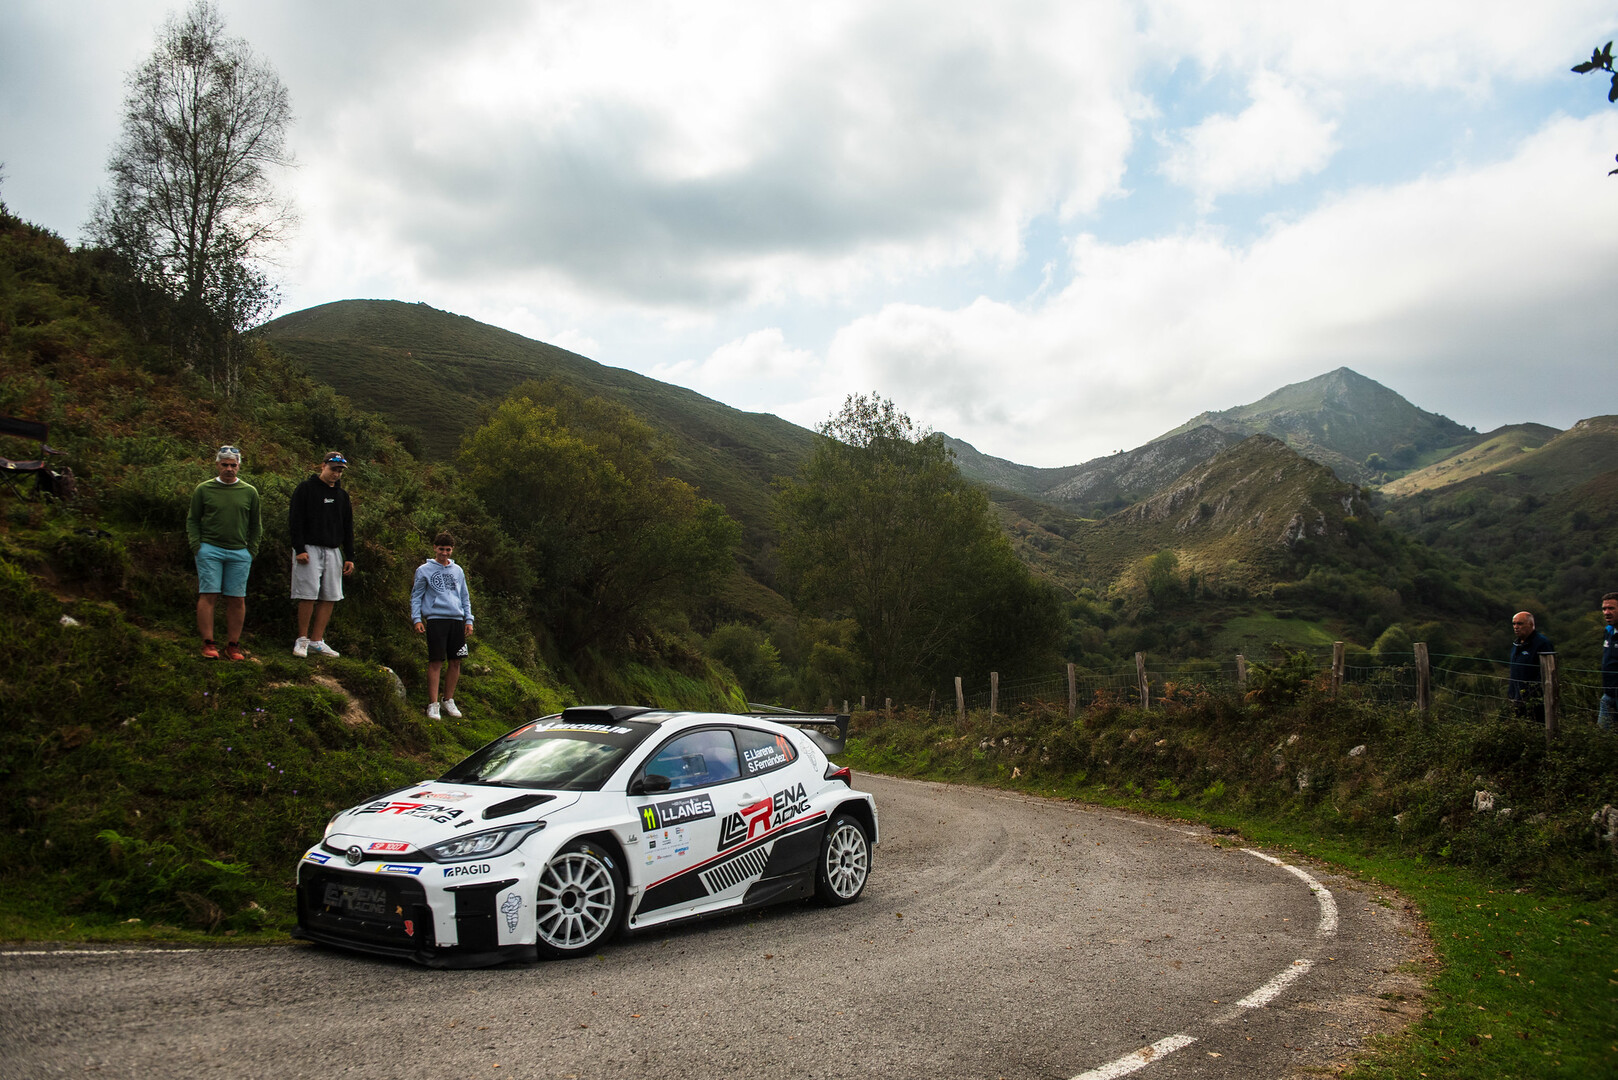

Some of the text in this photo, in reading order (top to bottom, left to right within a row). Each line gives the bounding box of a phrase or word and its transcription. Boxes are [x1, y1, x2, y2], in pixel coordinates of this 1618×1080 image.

[552, 723, 633, 735] MICHELIN
[743, 745, 775, 762] E.Llarena
[775, 733, 794, 763] 11
[643, 807, 657, 830] 11
[661, 800, 713, 822] LLANES
[373, 842, 405, 851] SP 1007
[454, 864, 491, 877] PAGID
